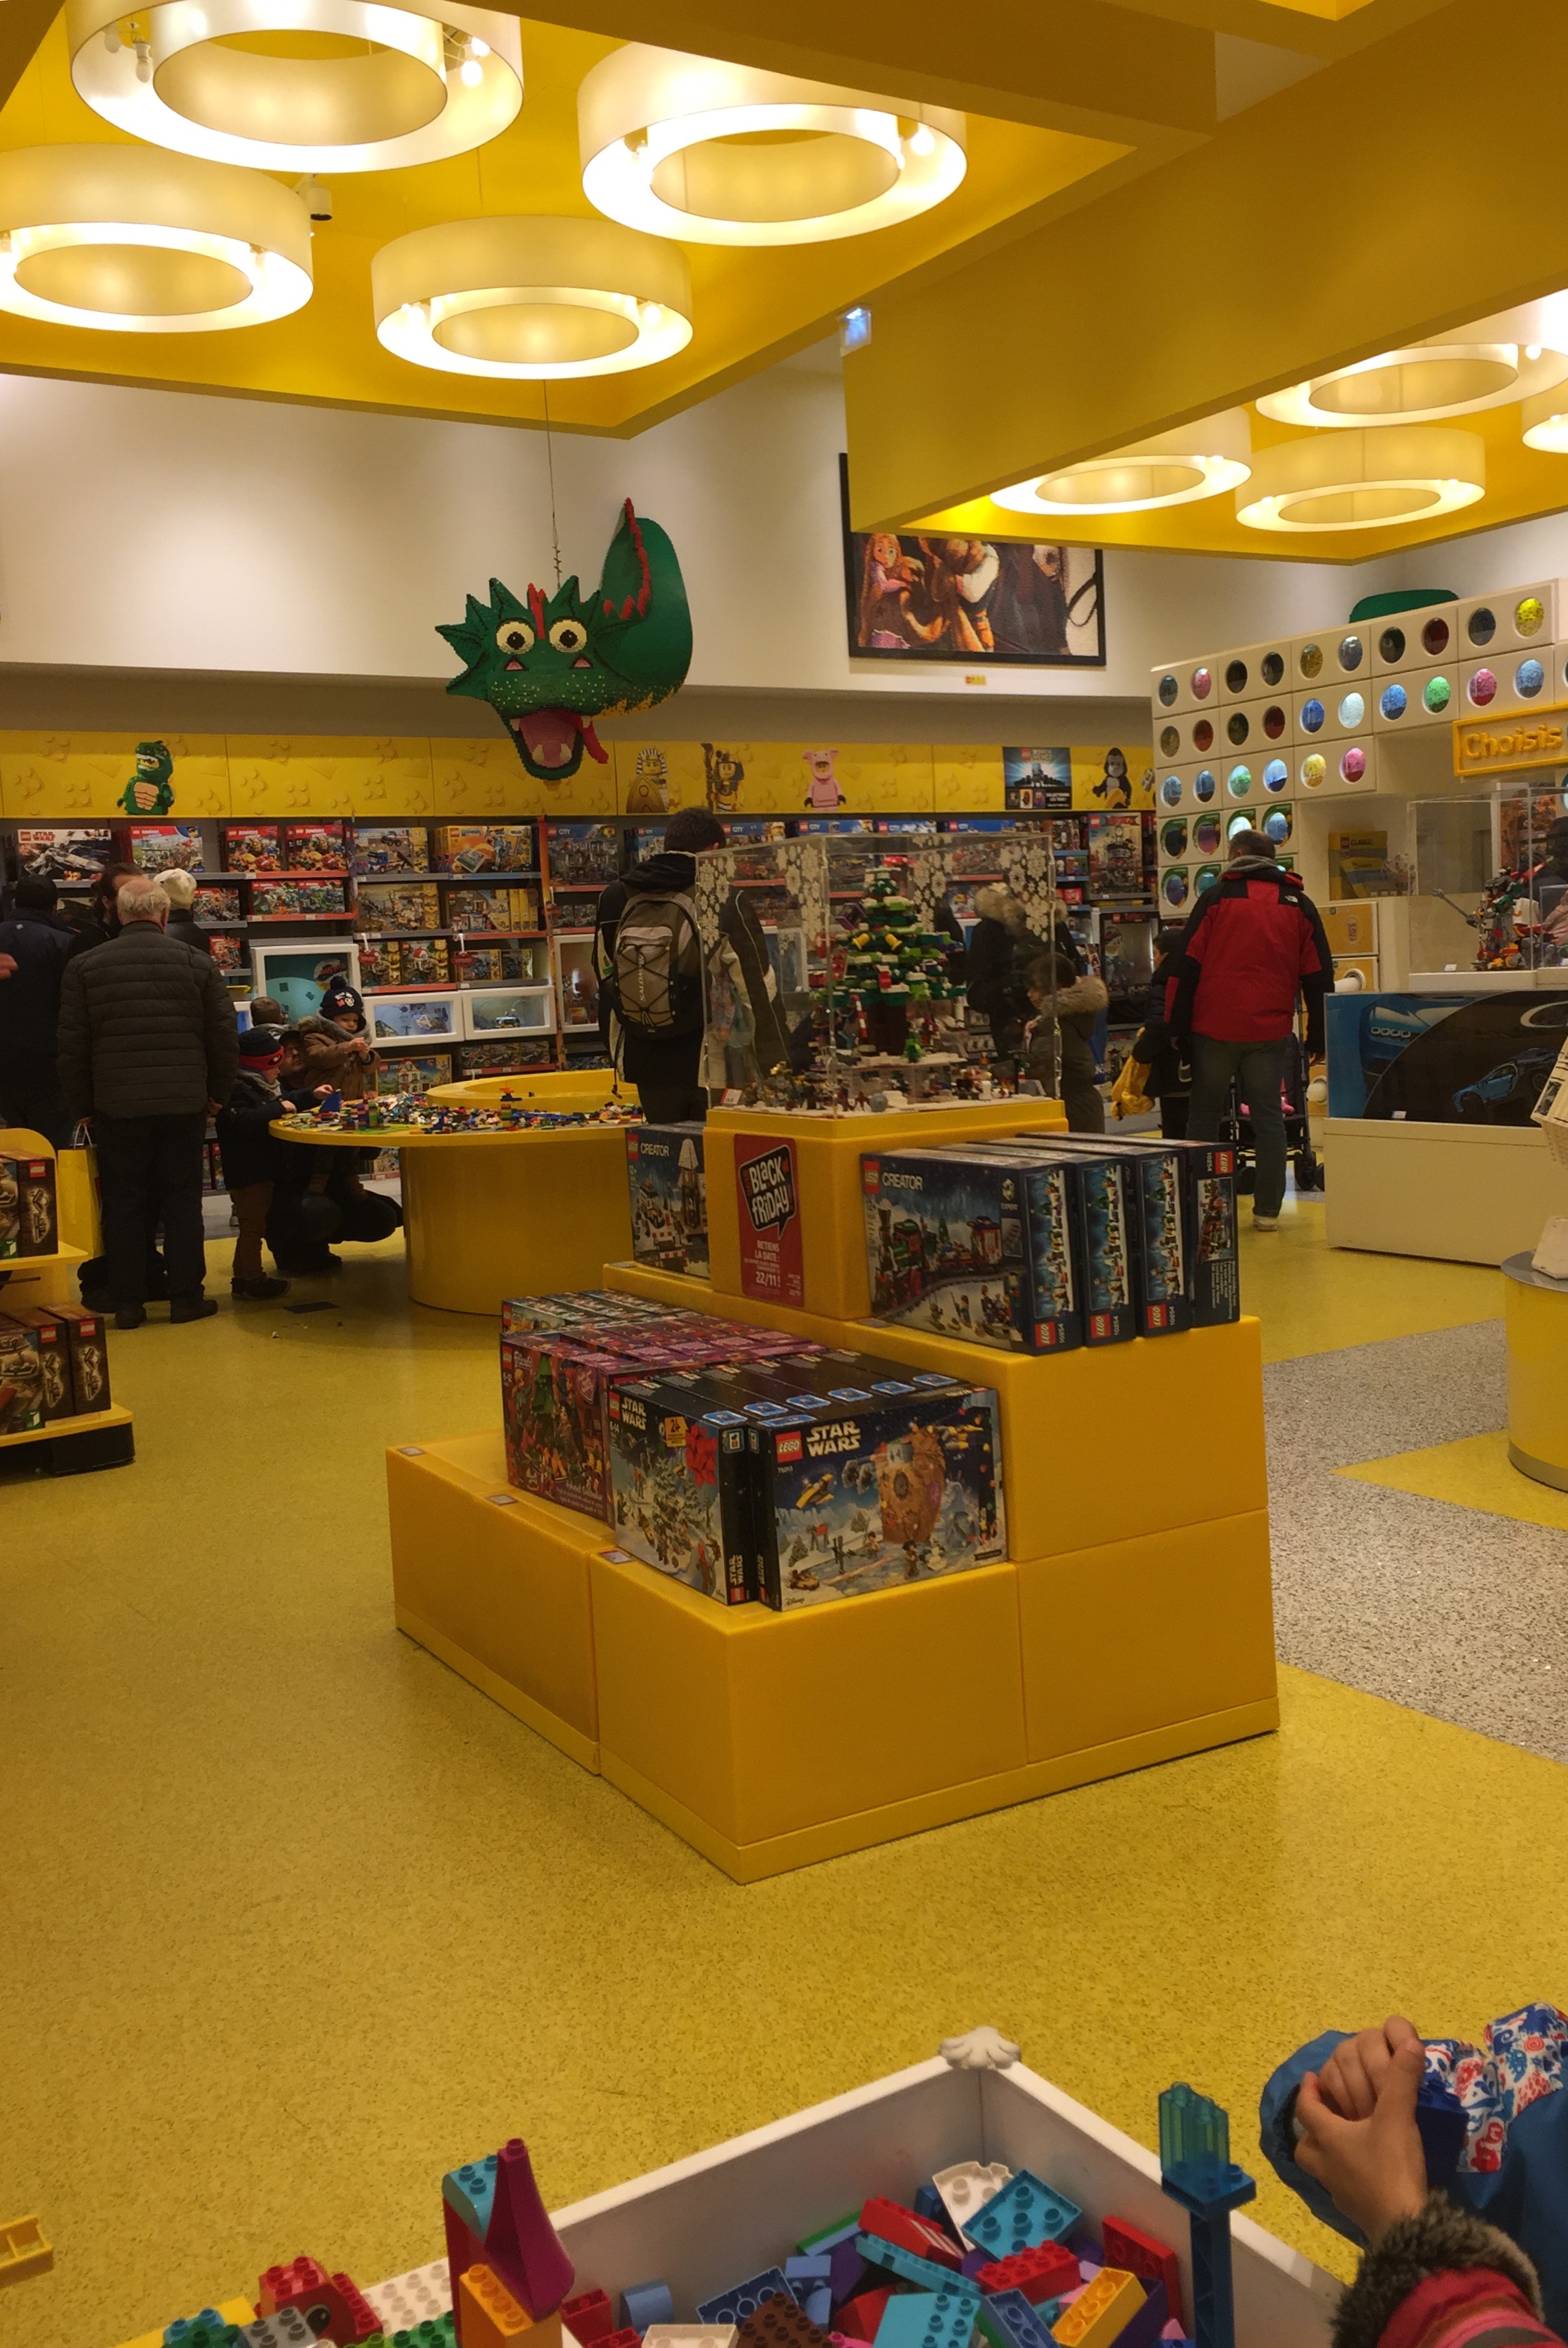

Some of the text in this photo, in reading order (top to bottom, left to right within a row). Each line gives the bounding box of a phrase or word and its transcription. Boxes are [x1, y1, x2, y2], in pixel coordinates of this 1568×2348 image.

[1464, 724, 1563, 759] Choisis
[640, 1142, 670, 1157] CREATOR
[1220, 1153, 1228, 1172] LEGO
[882, 1172, 924, 1191] CREATOR
[755, 1249, 762, 1259] LA
[1096, 1316, 1104, 1336] LEGO
[1152, 1306, 1161, 1326] LEGO
[1040, 1325, 1050, 1344] LEGO
[622, 1397, 647, 1417] STAR
[622, 1410, 647, 1431] WARS
[670, 1419, 680, 1433] 24
[778, 1420, 861, 1454] LEGO STAR
[806, 1434, 861, 1458] WARS
[728, 1554, 737, 1586] STAR
[735, 1554, 743, 1585] WARS
